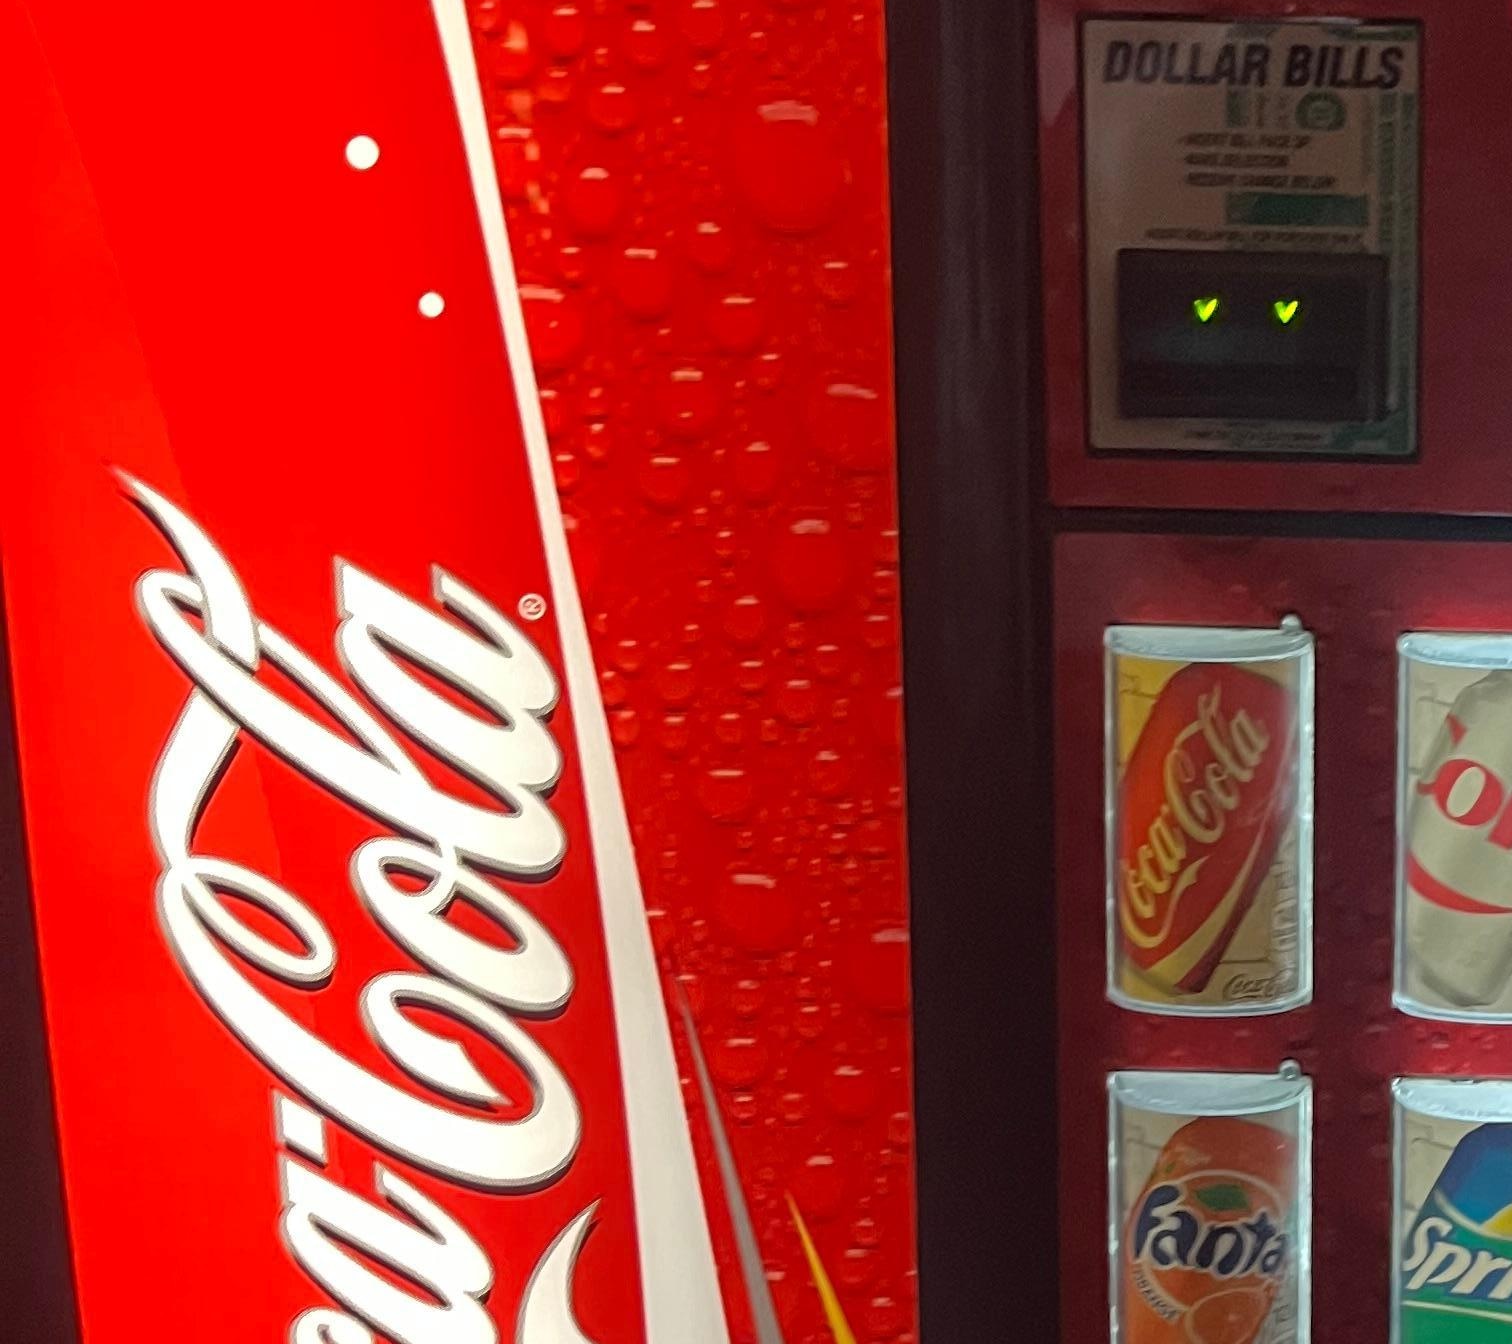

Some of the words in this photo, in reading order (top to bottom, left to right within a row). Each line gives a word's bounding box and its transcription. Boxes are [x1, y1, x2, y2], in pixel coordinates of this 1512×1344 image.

[1103, 39, 1270, 87] DOLLAR
[1285, 45, 1404, 89] BILLS
[1134, 1183, 1287, 1277] Fanta
